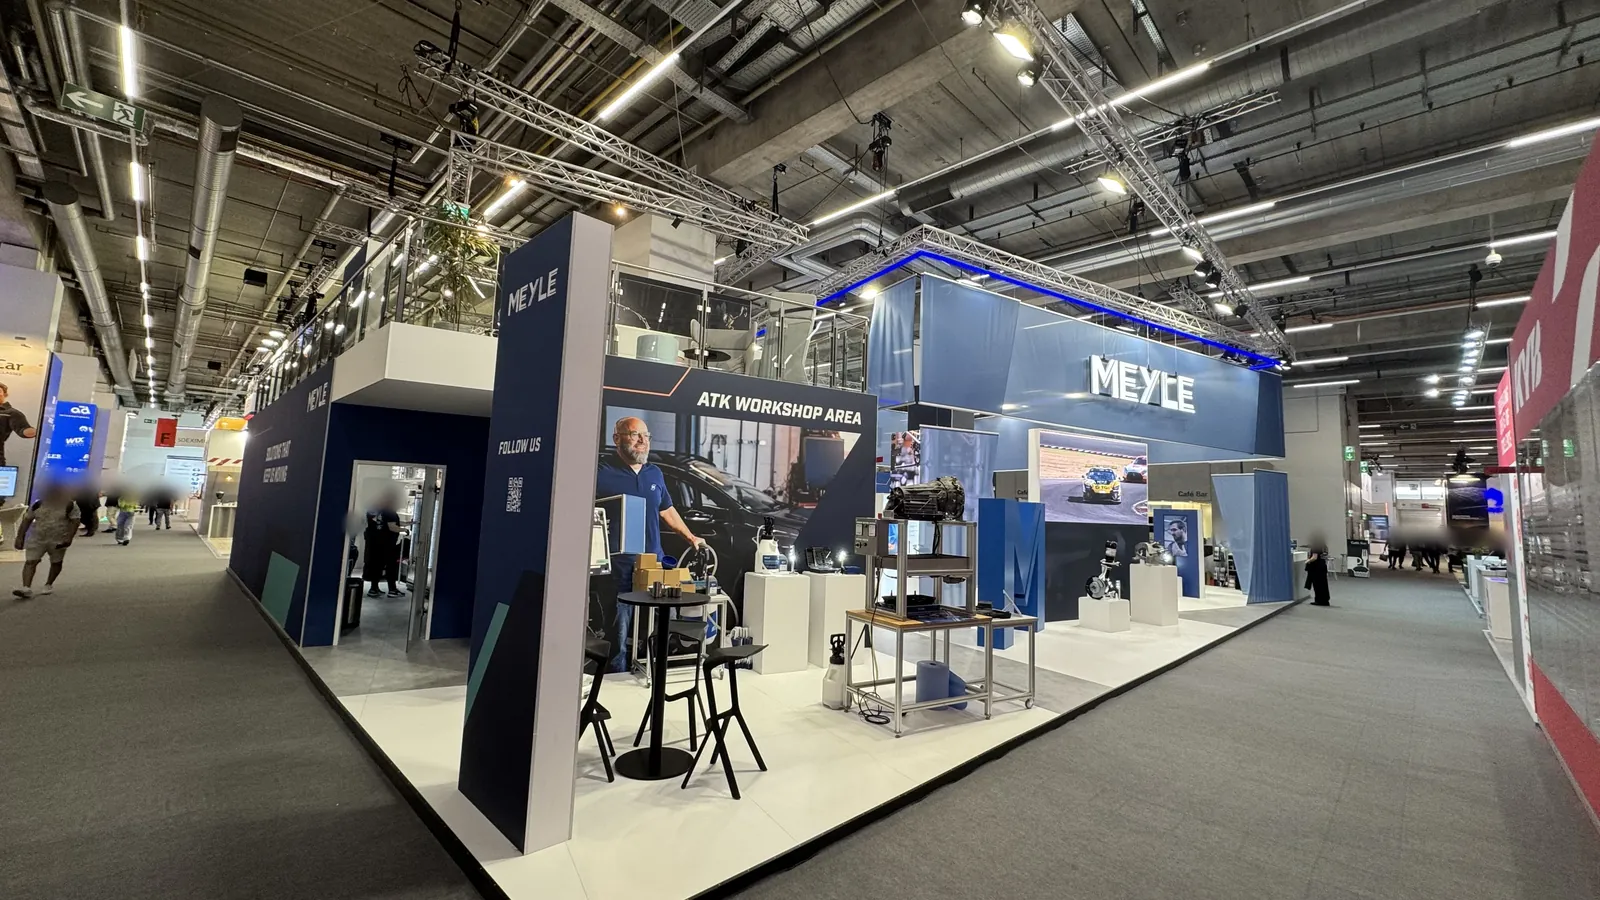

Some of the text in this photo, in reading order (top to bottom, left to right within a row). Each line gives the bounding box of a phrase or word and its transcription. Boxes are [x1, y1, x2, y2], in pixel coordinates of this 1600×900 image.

[508, 268, 559, 316] MEYLE
[1089, 354, 1196, 413] MEYLE
[1514, 319, 1542, 415] KYB
[306, 381, 329, 413] MEYLE
[697, 391, 862, 425] ATK WORKSHOP AREA
[160, 432, 171, 445] F
[498, 436, 542, 455] FOLLOW US
